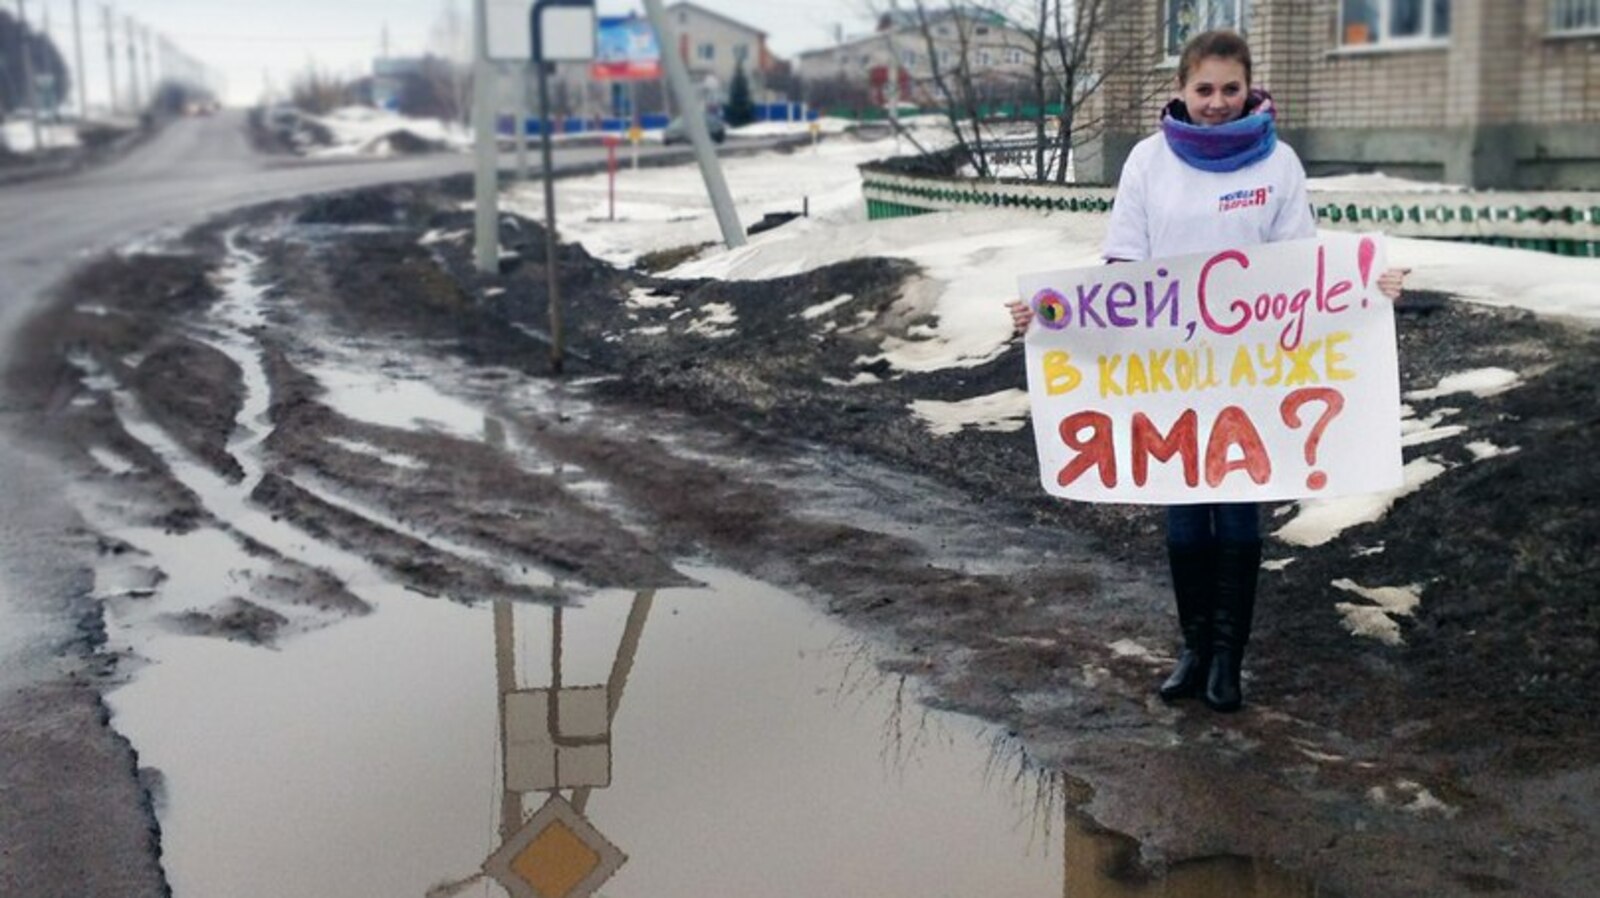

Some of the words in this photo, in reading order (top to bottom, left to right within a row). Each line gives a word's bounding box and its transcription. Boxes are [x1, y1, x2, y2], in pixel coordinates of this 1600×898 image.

[1198, 237, 1376, 351] Google!
[1043, 349, 1082, 396] В
[1099, 343, 1221, 397] КАКОЙ
